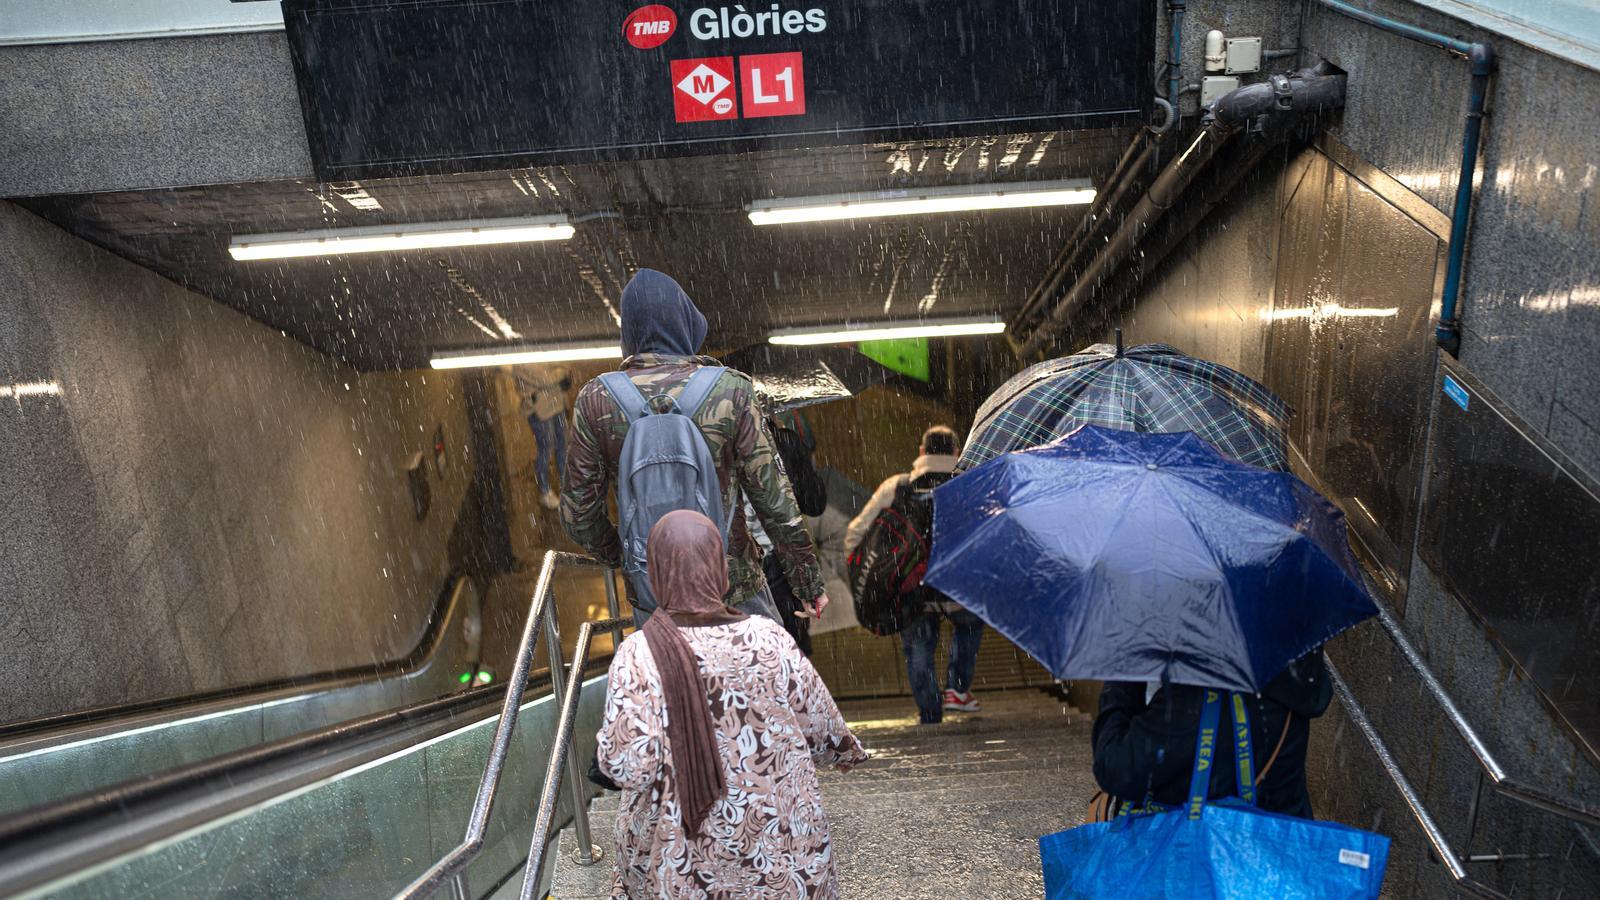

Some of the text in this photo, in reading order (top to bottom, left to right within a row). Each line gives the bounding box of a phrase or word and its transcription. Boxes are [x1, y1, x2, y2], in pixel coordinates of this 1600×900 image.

[633, 20, 671, 36] TMB
[689, 3, 827, 40] Glòries
[692, 74, 715, 94] M
[751, 66, 795, 105] L1
[1197, 728, 1214, 771] IKEA
